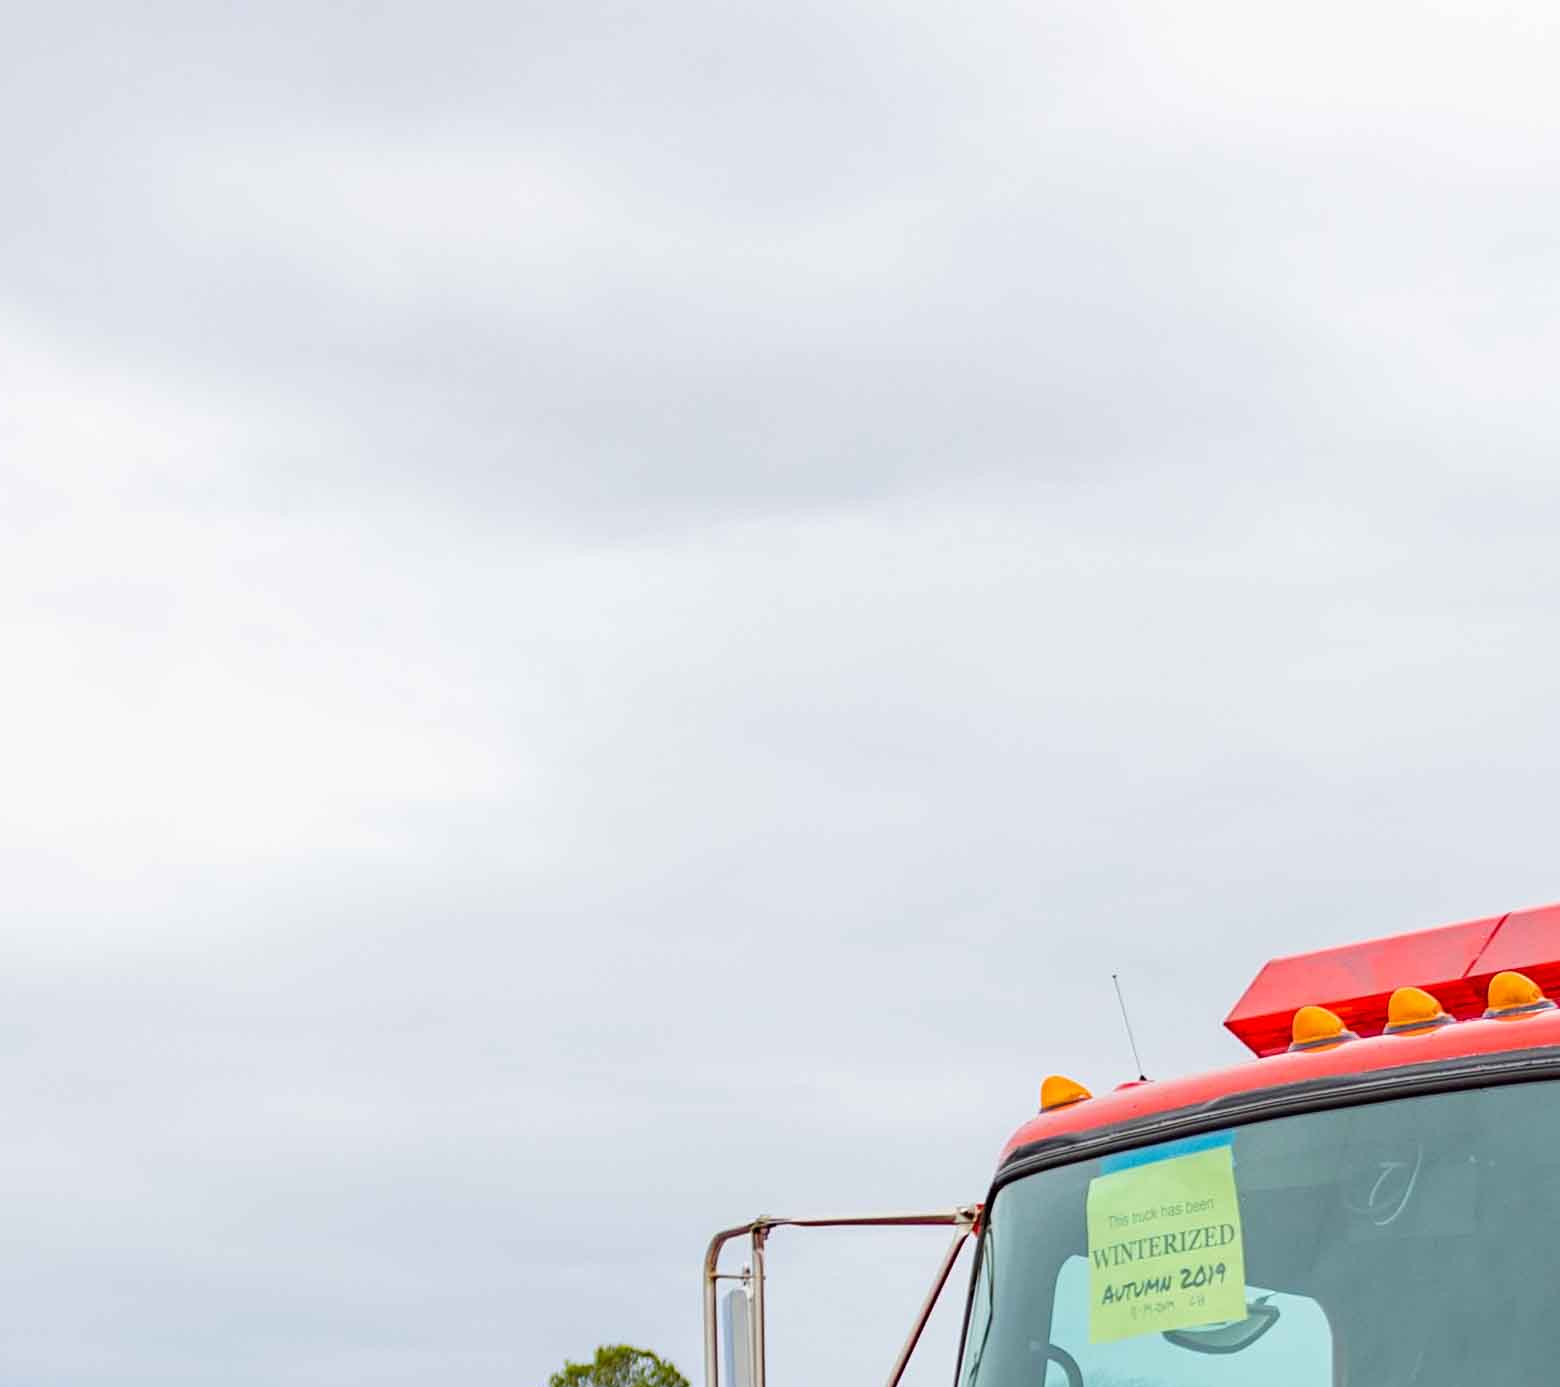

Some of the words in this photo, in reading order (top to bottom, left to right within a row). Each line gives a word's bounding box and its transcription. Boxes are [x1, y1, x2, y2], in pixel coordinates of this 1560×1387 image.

[1160, 1203, 1184, 1218] has
[1185, 1197, 1215, 1214] been
[1091, 1223, 1235, 1270] WINTERIZED
[1101, 1275, 1172, 1305] AUTUMN
[1180, 1262, 1226, 1289] 2019
